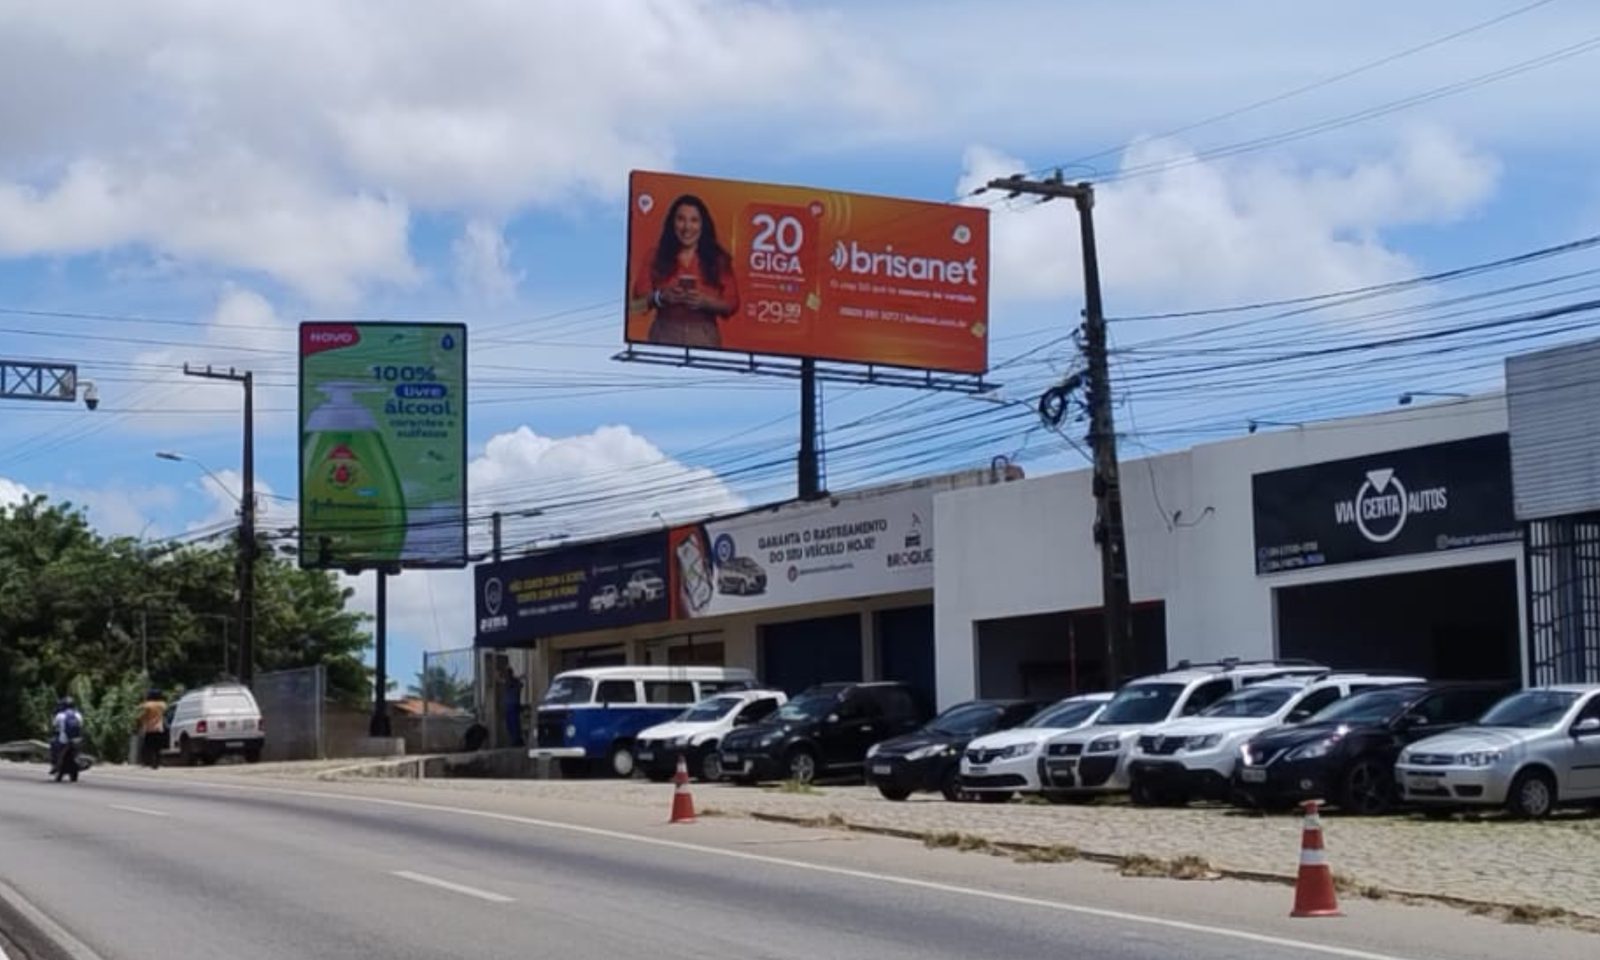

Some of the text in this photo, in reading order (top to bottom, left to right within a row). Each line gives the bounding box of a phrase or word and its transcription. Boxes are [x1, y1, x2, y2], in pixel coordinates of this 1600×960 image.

[752, 214, 803, 253] 20
[750, 252, 803, 274] GIGA
[851, 242, 978, 285] brisanet
[310, 331, 353, 343] NOVO
[373, 365, 437, 381] 100%
[404, 385, 442, 397] livre
[1335, 487, 1447, 524] VIA CERTA AUTOS
[758, 519, 887, 549] GARANTA O RASTREAMENTO
[769, 551, 784, 564] DO
[786, 548, 802, 561] SEU
